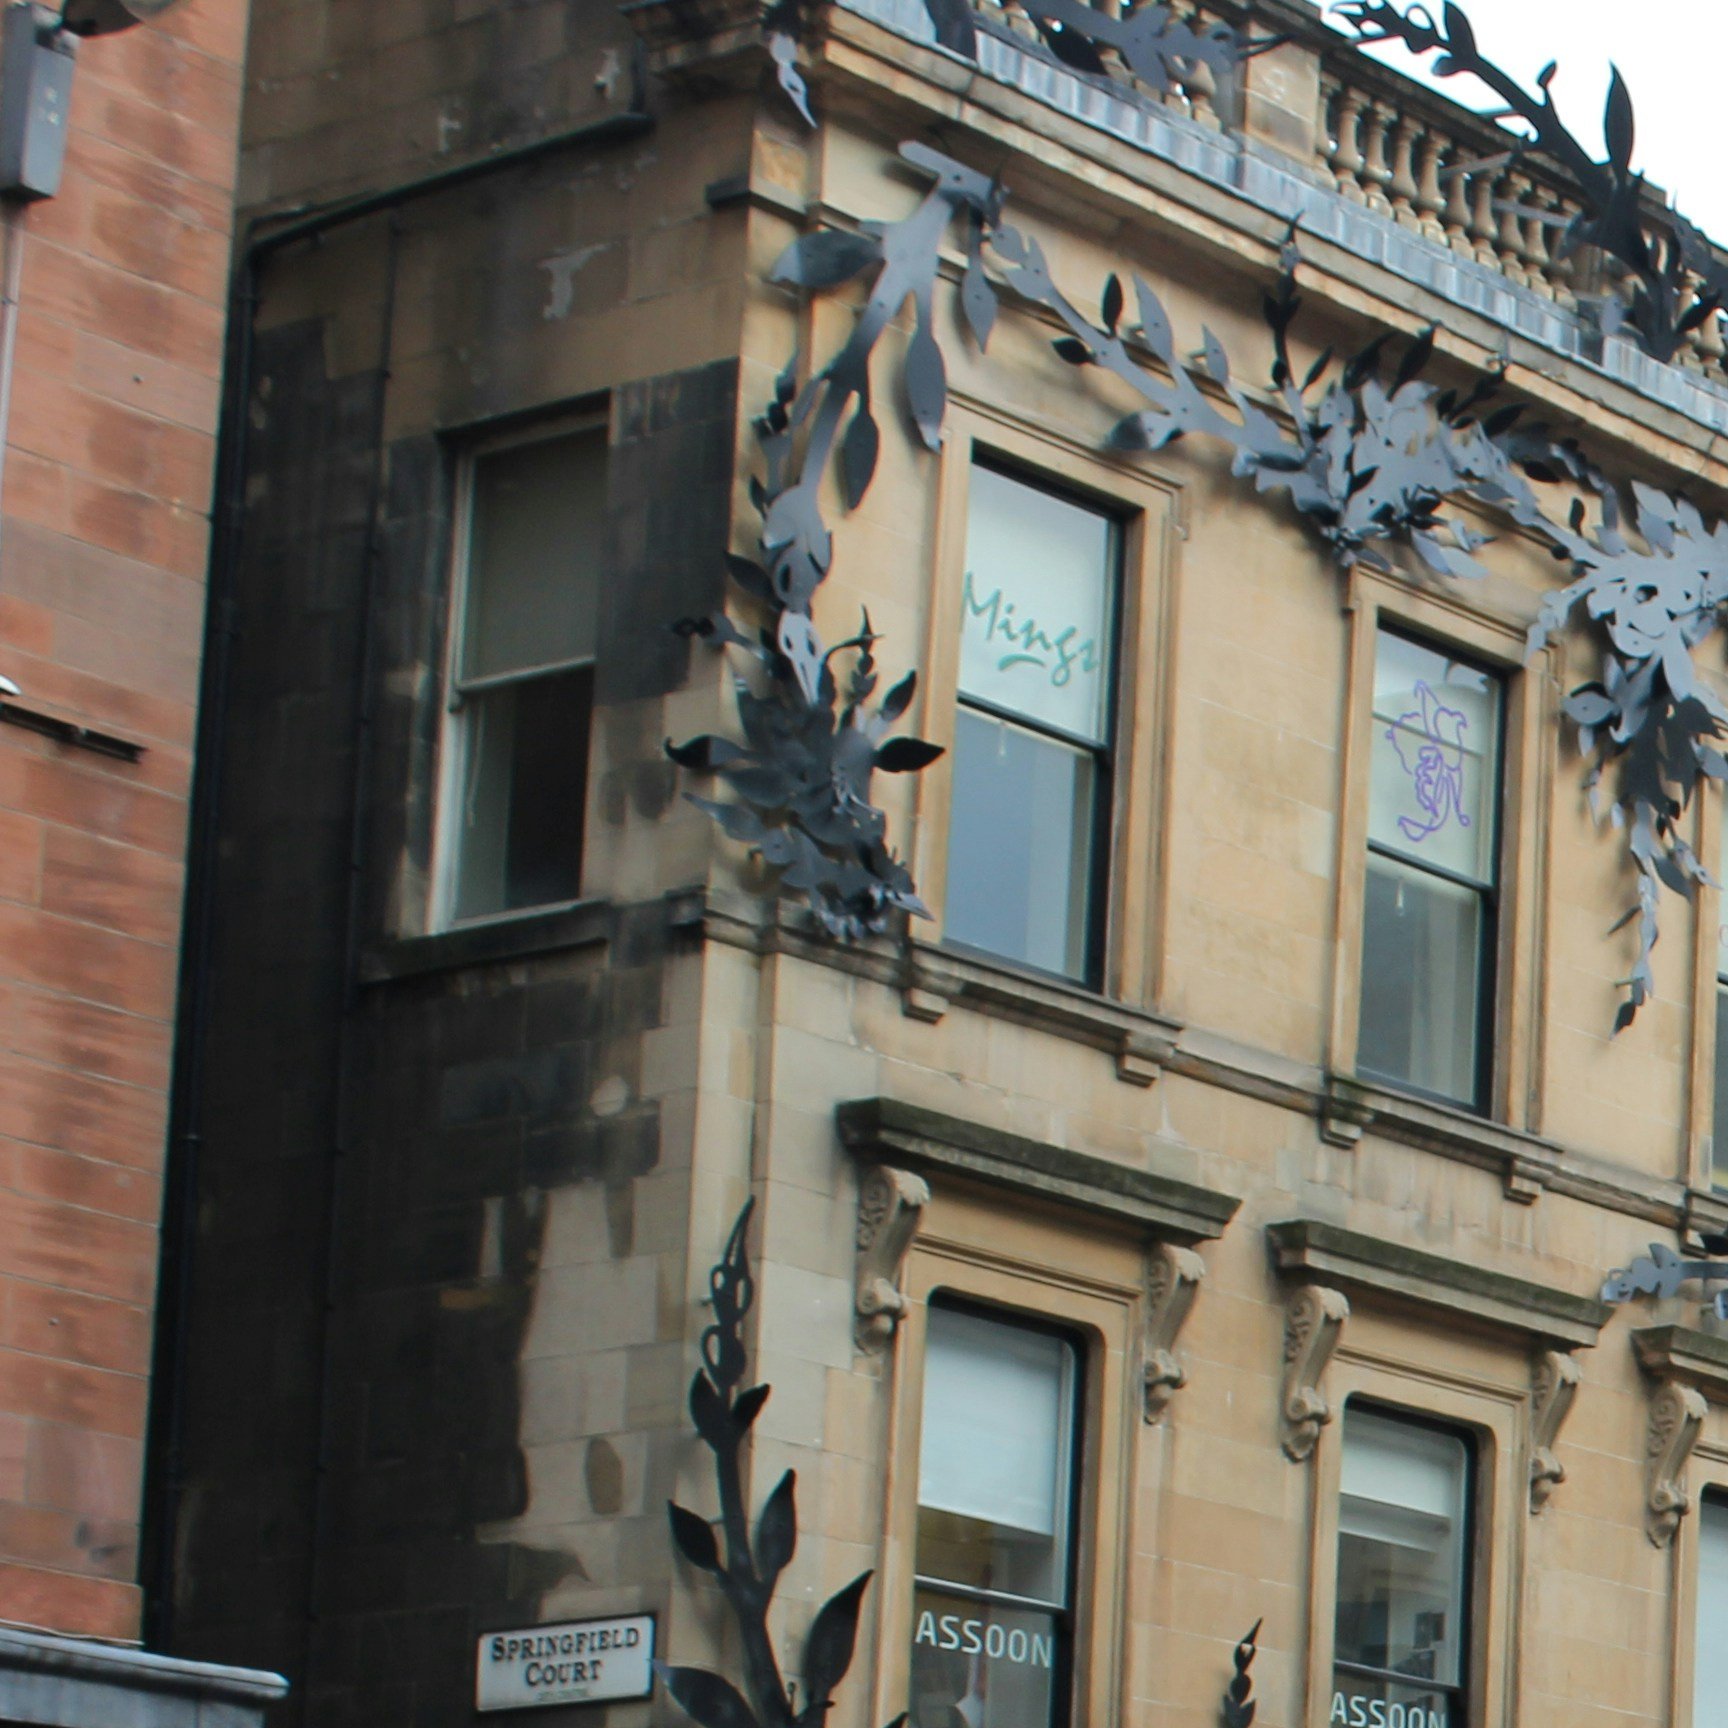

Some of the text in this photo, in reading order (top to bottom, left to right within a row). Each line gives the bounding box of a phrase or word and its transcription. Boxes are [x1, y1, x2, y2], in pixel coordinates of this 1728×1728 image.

[962, 571, 1099, 687] Mings
[491, 1627, 640, 1662] SPRINGFIELD
[915, 1609, 1053, 1668] ASSOON
[525, 1659, 603, 1687] COURT
